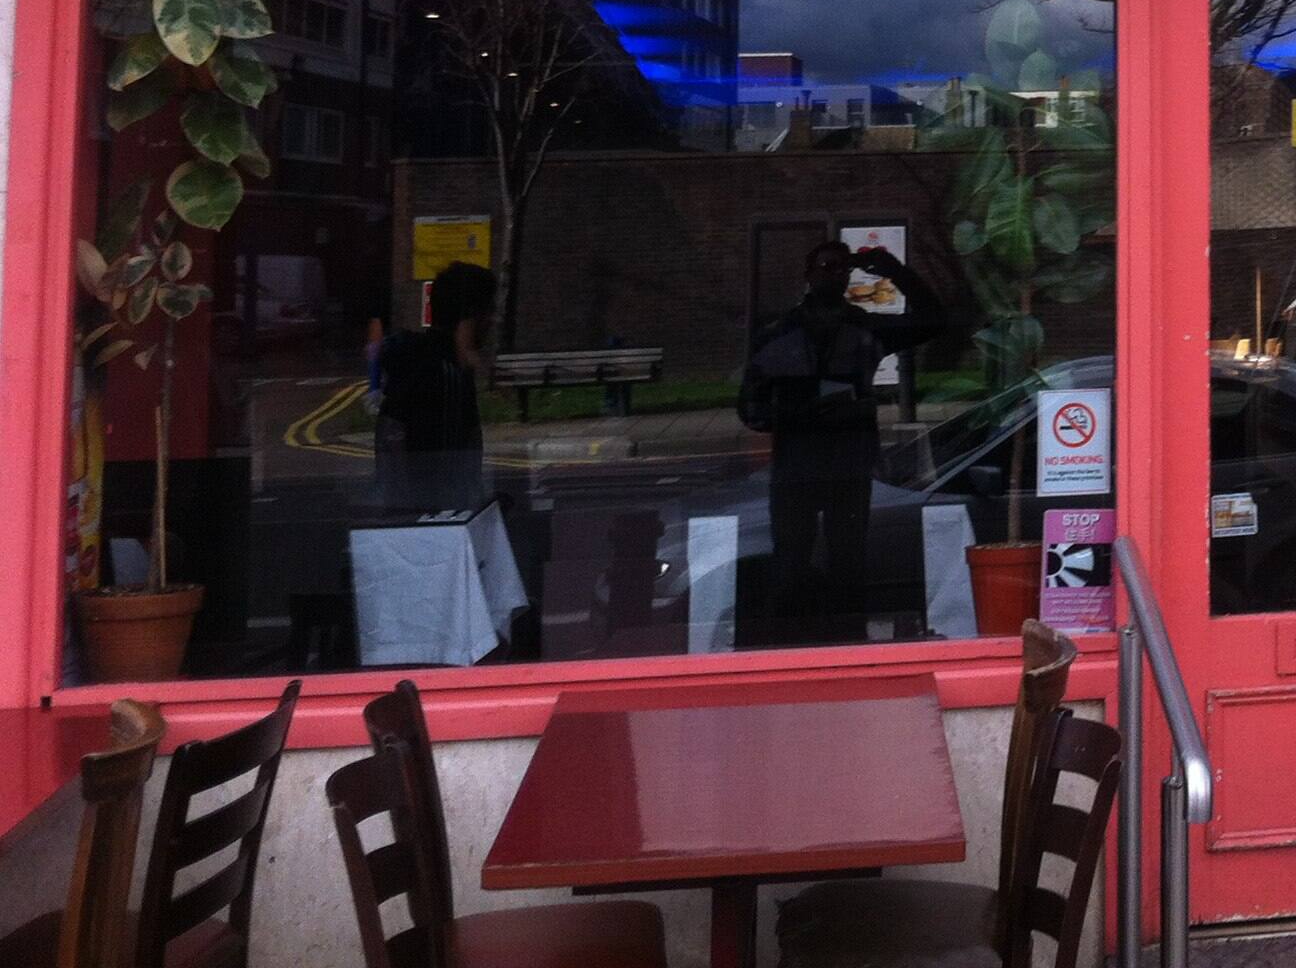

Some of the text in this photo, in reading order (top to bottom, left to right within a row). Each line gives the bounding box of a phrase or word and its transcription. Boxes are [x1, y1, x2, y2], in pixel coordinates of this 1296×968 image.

[1044, 455, 1104, 466] NO SMOKING
[1062, 513, 1100, 526] STOP
